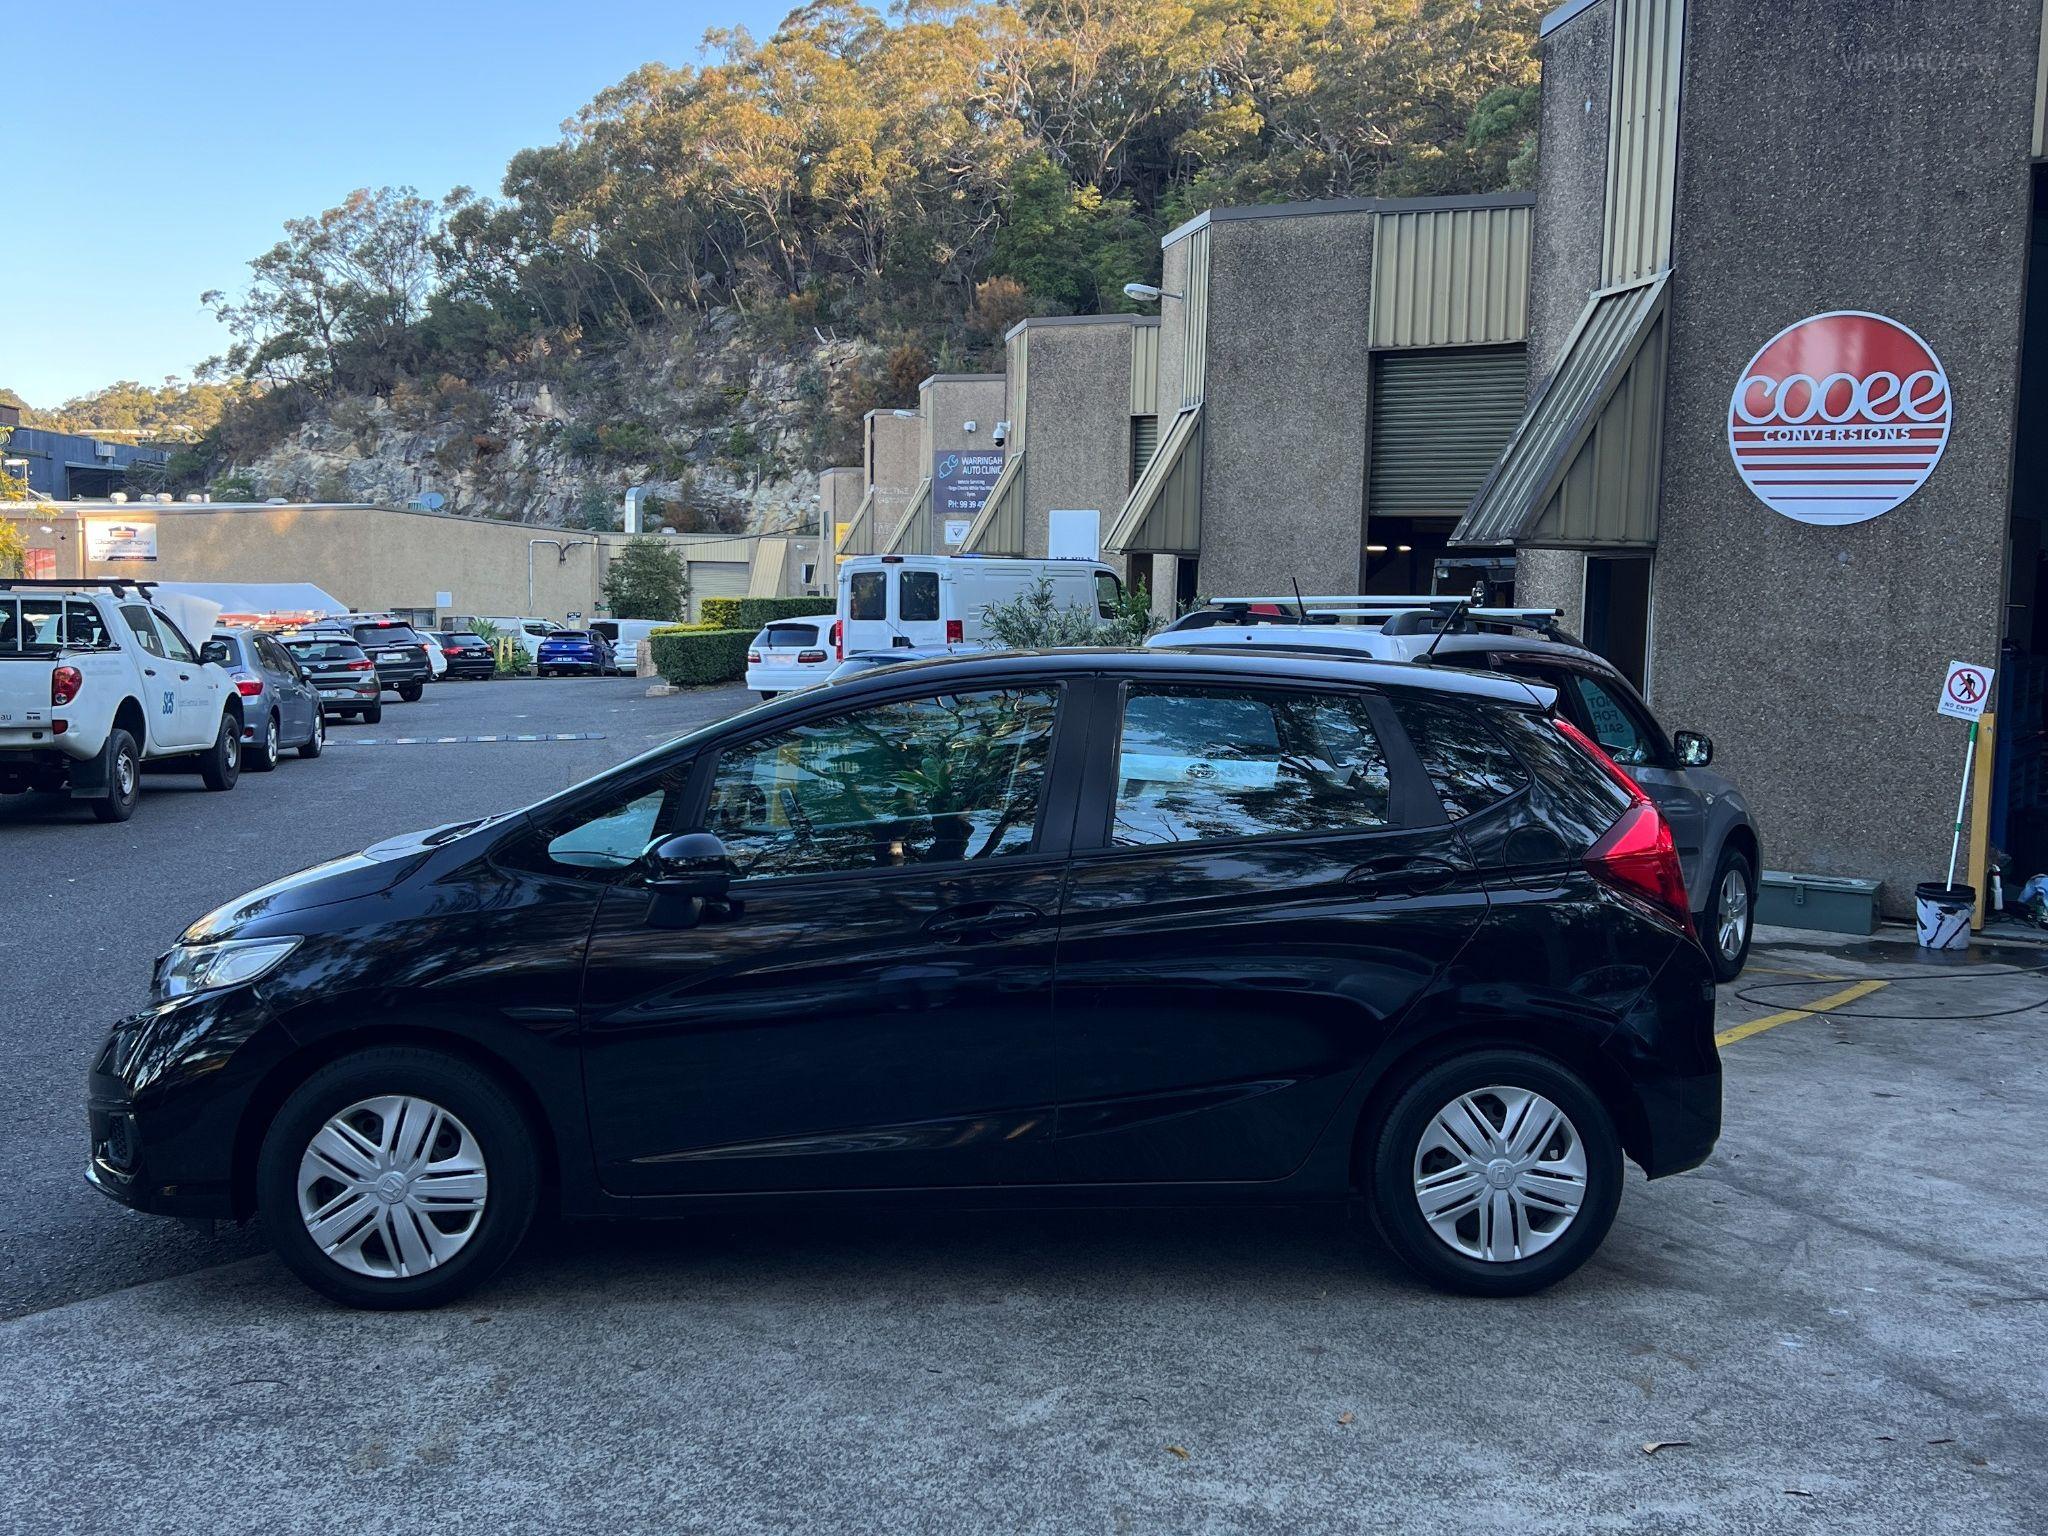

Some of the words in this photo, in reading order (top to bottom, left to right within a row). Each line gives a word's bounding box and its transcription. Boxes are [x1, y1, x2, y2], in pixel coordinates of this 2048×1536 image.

[1763, 428, 1911, 441] CONVERSIONS
[961, 456, 1003, 465] WARRINGAH
[962, 465, 981, 475] AUTO
[981, 465, 1002, 475] CLINIC
[1956, 704, 1978, 713] ENTRY
